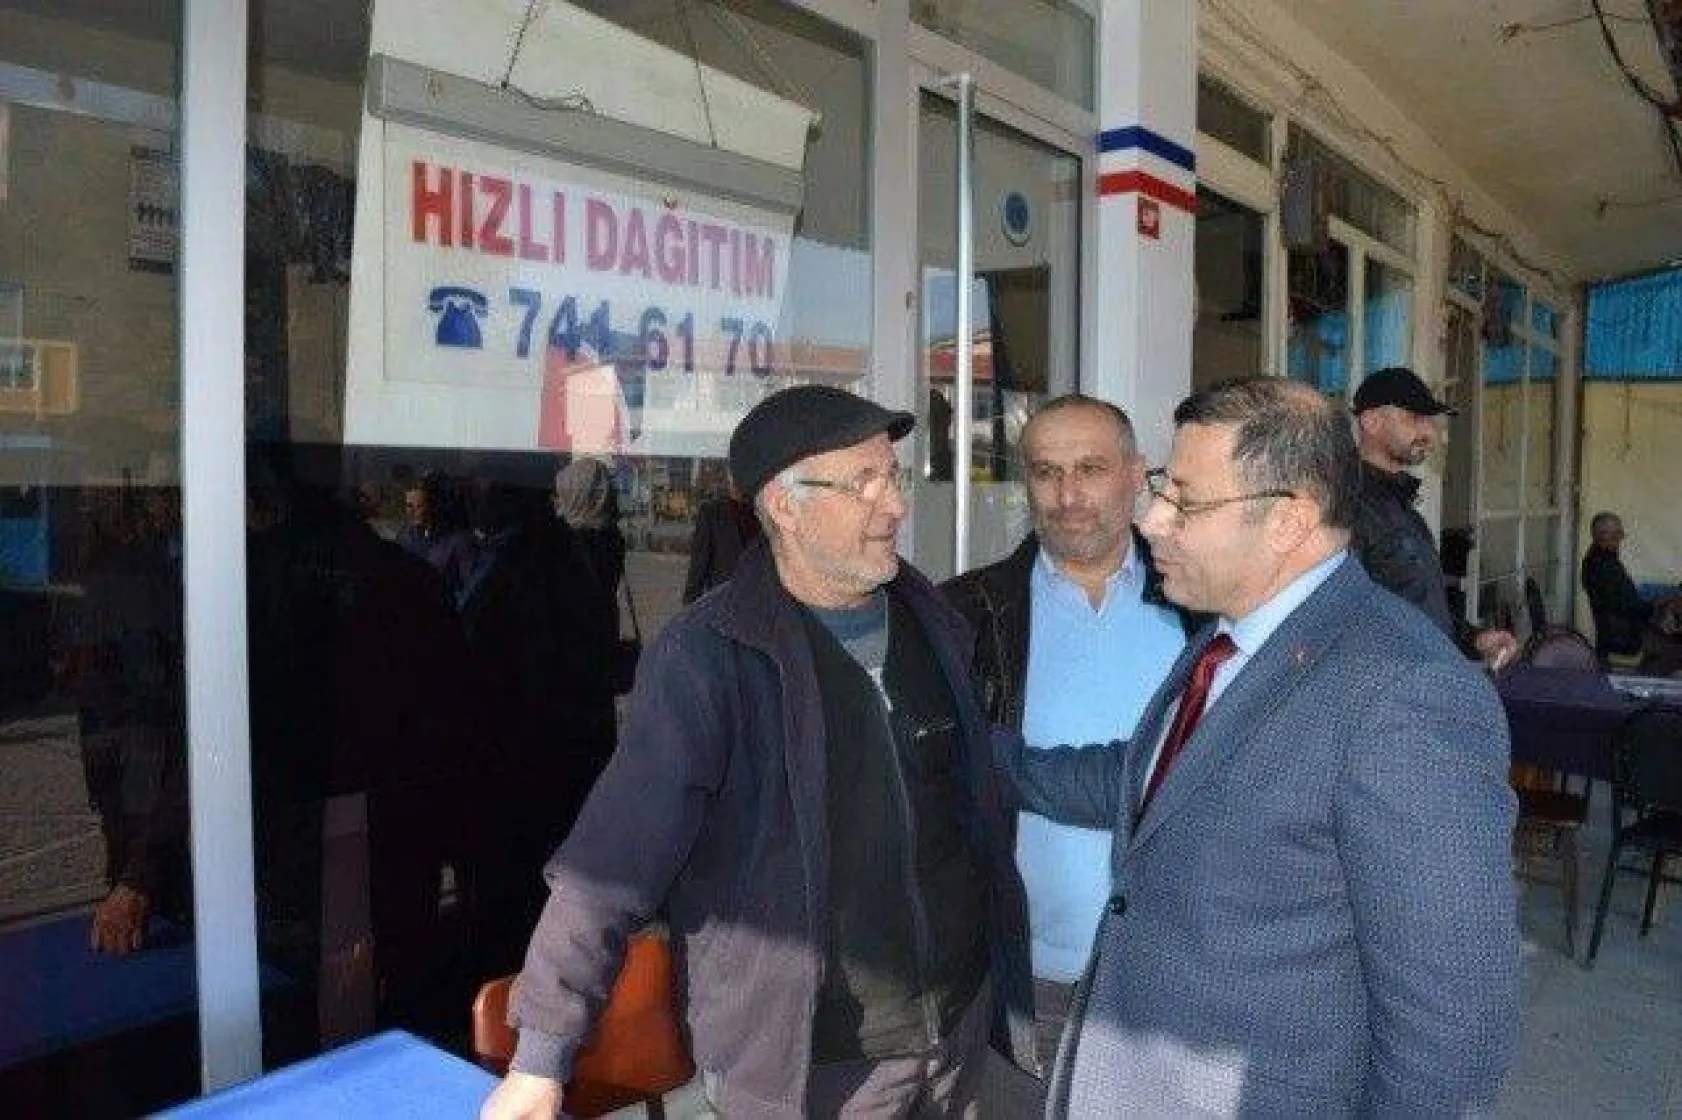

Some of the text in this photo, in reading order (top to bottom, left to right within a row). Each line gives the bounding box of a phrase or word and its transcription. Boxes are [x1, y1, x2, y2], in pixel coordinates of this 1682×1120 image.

[412, 161, 775, 299] HIZLI DAĞITIM
[640, 305, 695, 373] 61
[721, 316, 774, 377] 70
